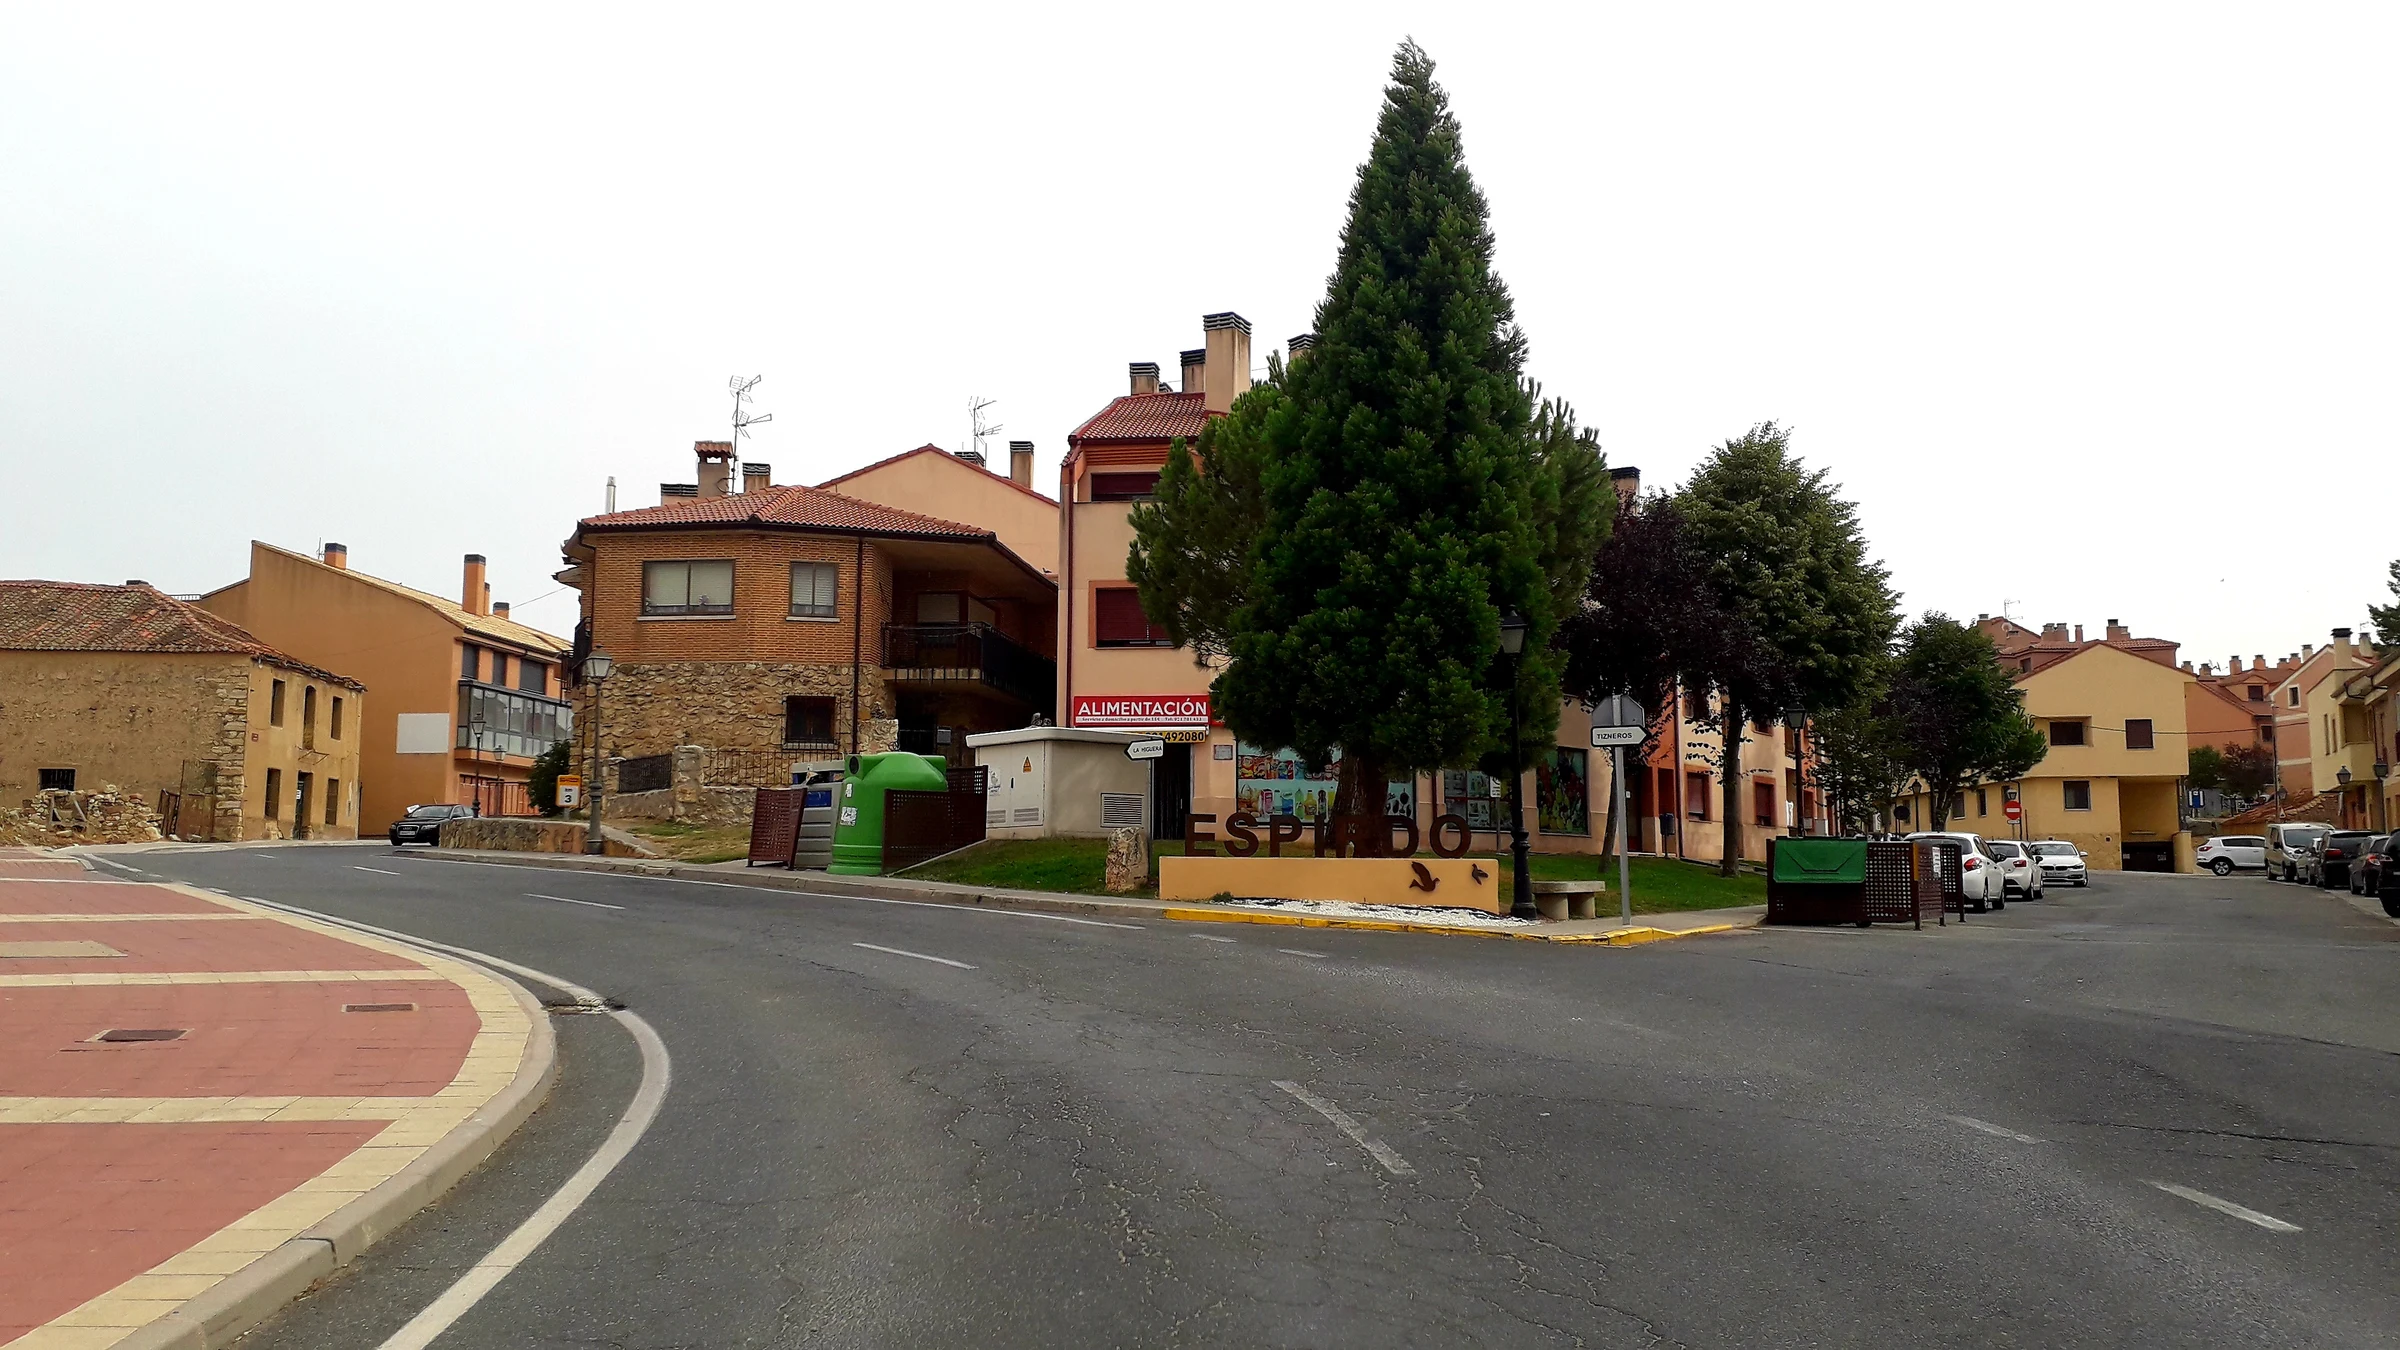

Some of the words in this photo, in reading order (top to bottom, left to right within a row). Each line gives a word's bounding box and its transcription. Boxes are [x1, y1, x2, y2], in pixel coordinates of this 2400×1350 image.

[1078, 698, 1207, 715] ALIMENTACIÓN
[1141, 745, 1163, 753] HIGUERA
[565, 795, 572, 803] 3
